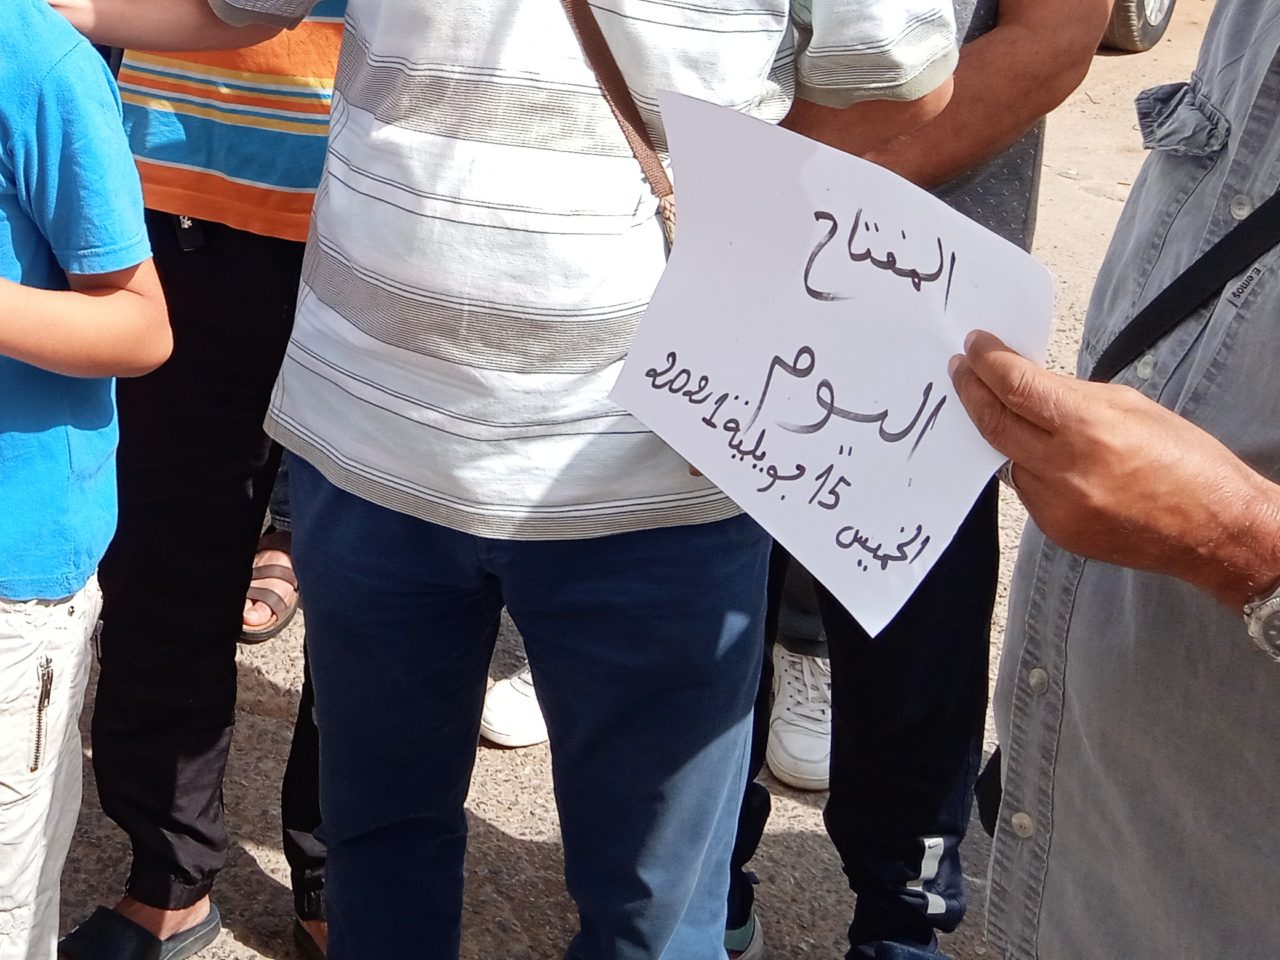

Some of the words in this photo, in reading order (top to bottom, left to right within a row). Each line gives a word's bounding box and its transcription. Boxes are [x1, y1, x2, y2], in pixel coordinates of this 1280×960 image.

[803, 208, 956, 312] المفتاح
[644, 351, 729, 430] 2021
[744, 344, 947, 463] اليوم
[808, 463, 852, 511] 15
[835, 523, 931, 572] الخميس
